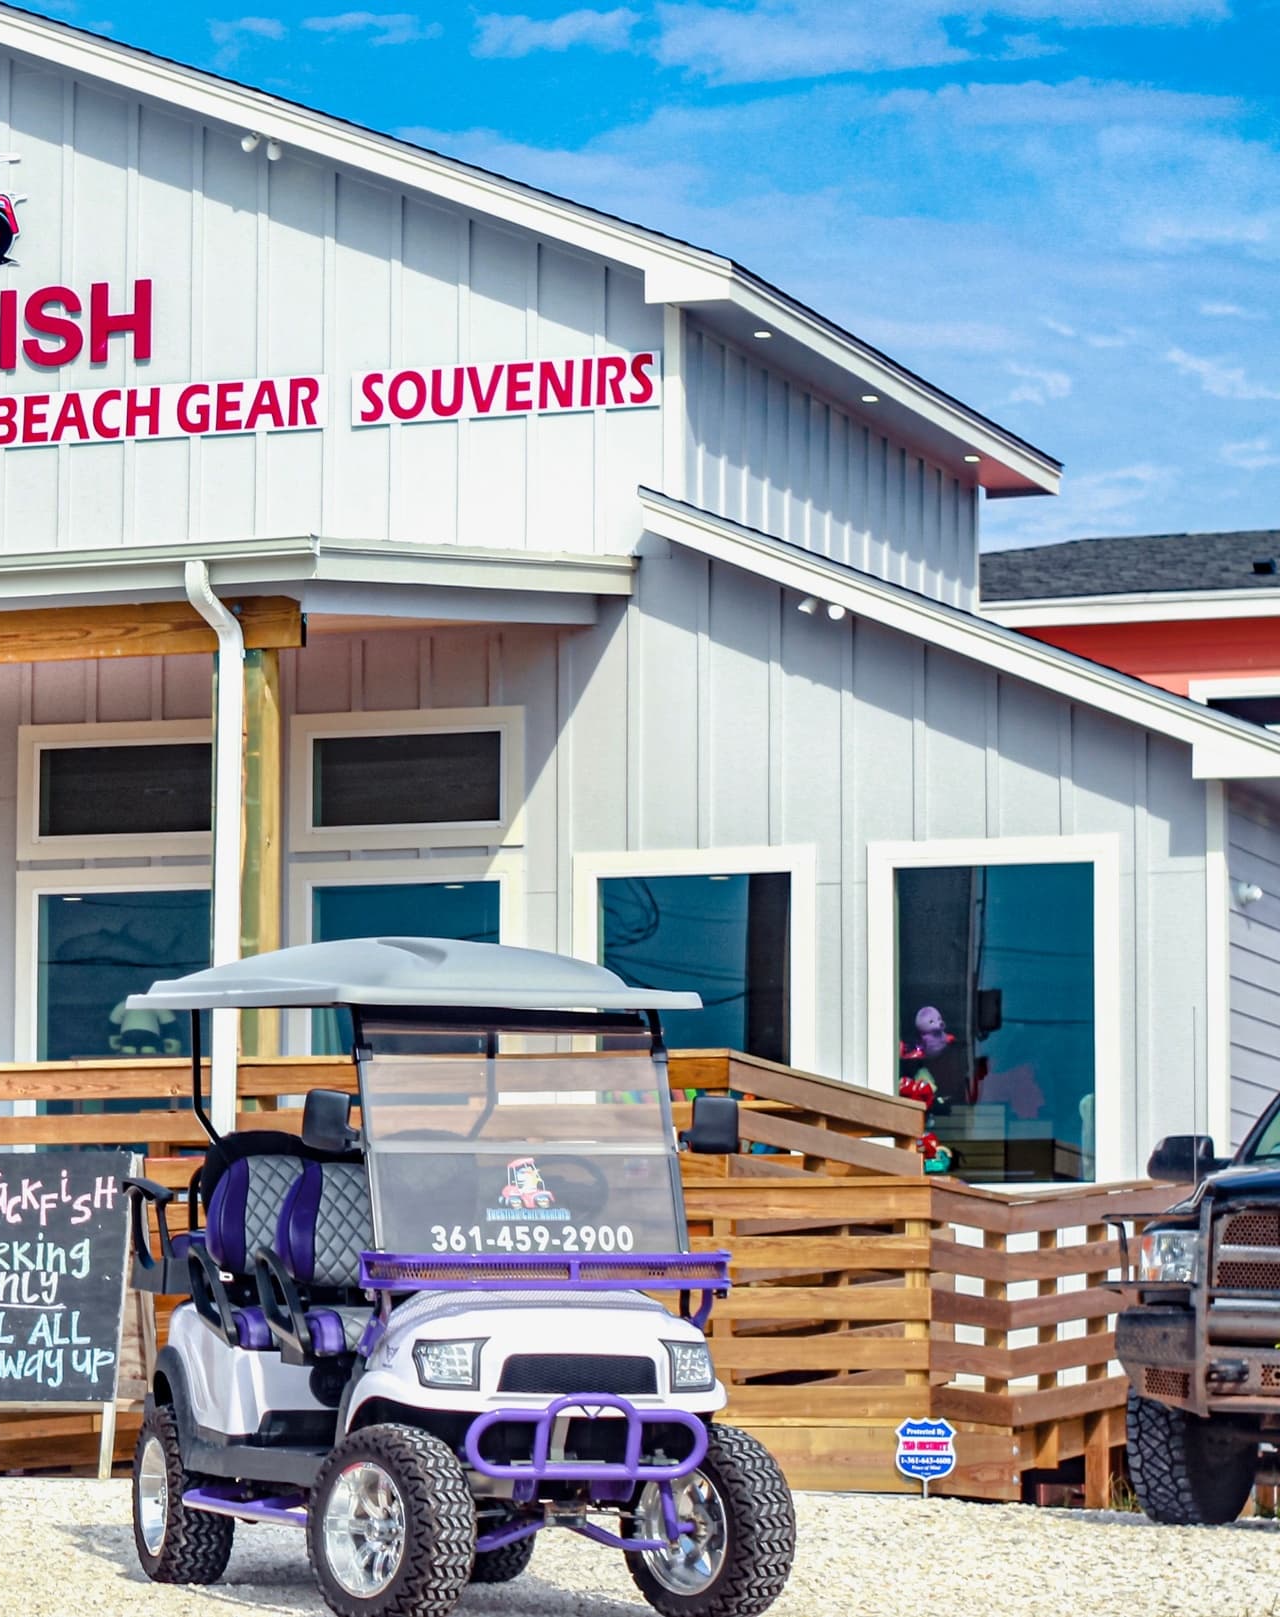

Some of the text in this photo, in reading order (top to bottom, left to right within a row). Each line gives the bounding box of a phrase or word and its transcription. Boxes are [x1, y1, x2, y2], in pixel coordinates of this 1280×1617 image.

[176, 377, 319, 434] GEAR
[360, 353, 653, 422] SOUVENIRS
[430, 1225, 634, 1252] 361-459-2900
[28, 1310, 91, 1347] ALL
